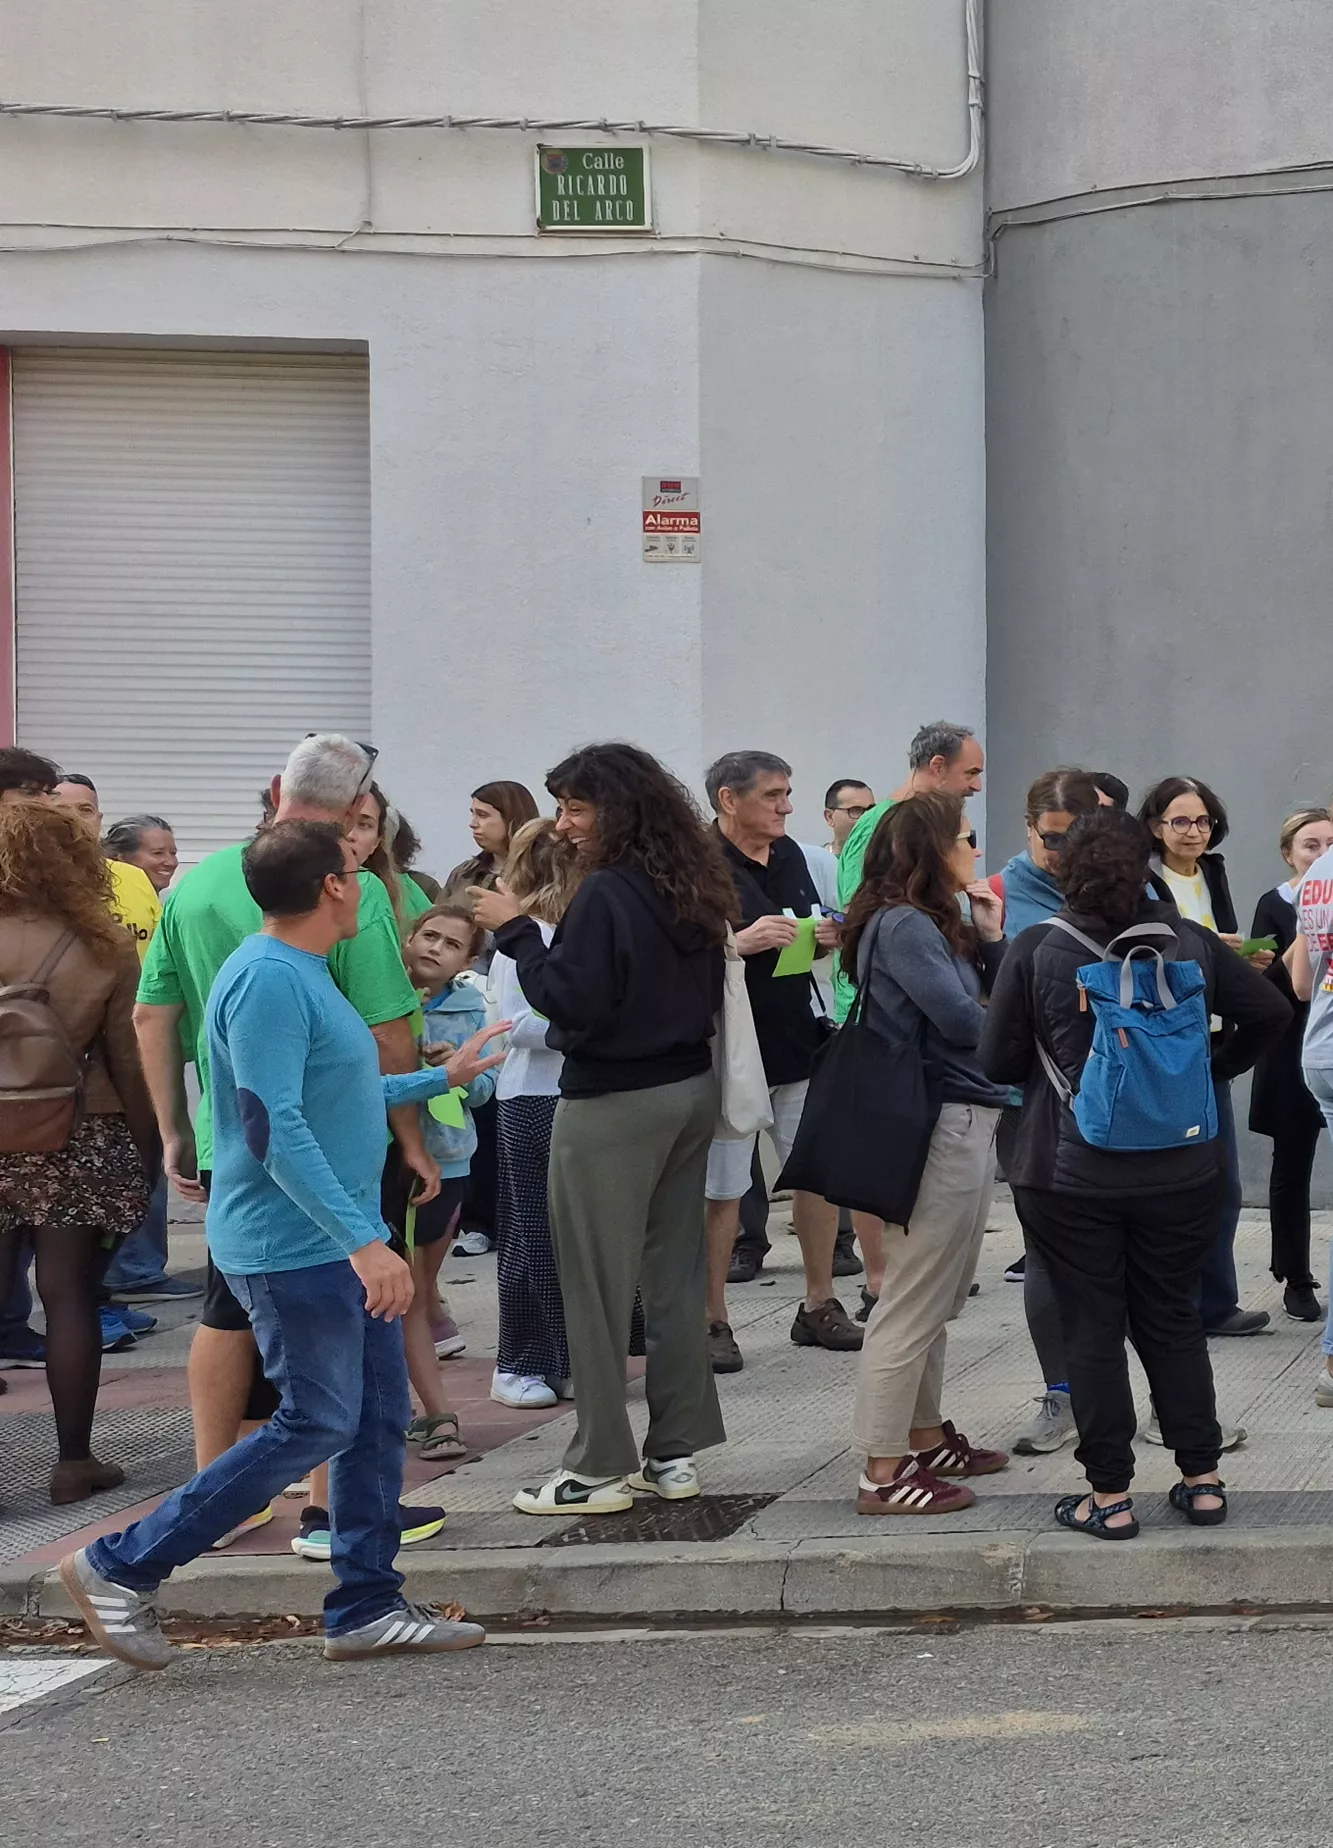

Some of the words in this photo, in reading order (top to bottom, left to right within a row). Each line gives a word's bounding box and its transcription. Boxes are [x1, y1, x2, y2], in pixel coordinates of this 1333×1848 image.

[582, 152, 625, 170] Calle
[557, 174, 627, 196] RICARDO
[552, 200, 580, 221] DEL
[595, 200, 633, 221] ARCO
[645, 513, 698, 526] Alarma
[1303, 908, 1314, 930] ES
[1316, 907, 1331, 929] UN
